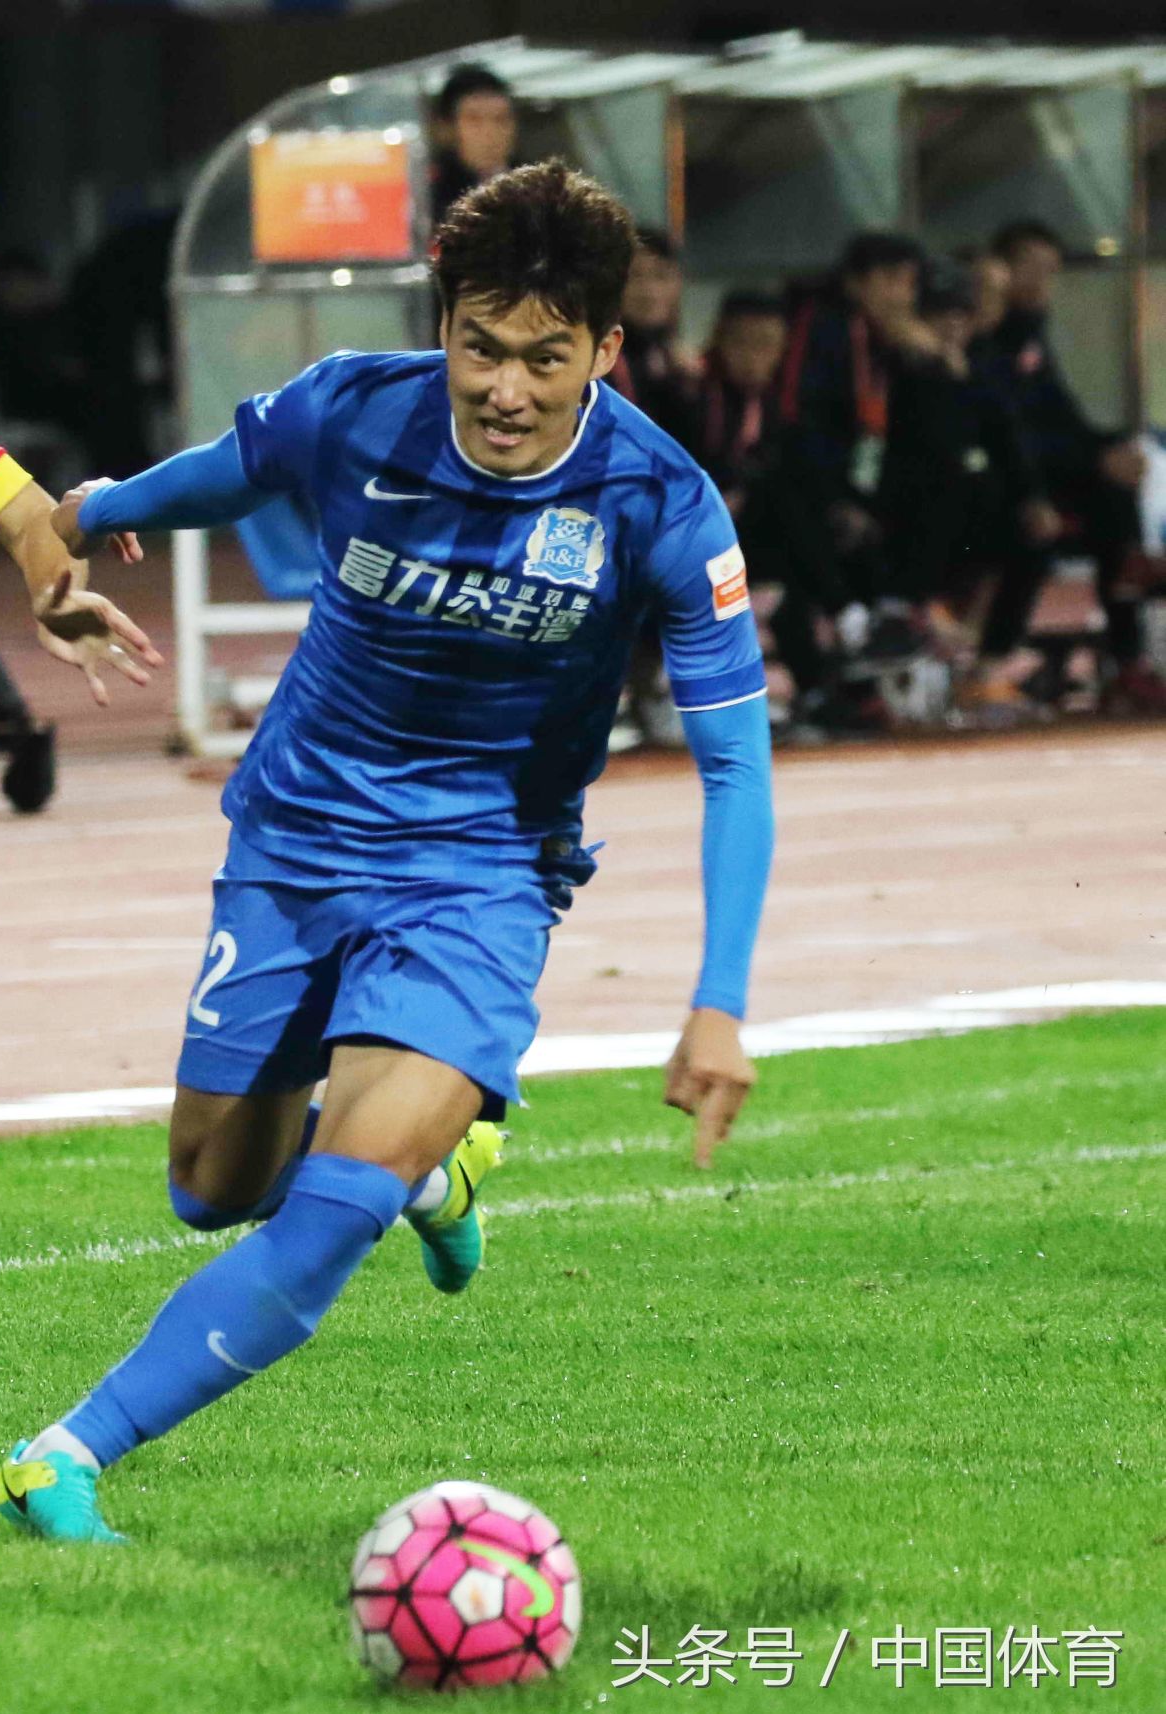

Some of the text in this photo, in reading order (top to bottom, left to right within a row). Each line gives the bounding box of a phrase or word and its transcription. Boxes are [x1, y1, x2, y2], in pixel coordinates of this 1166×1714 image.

[338, 537, 587, 643] 富力公主湾
[544, 548, 585, 567] R&F
[192, 930, 237, 1027] 2
